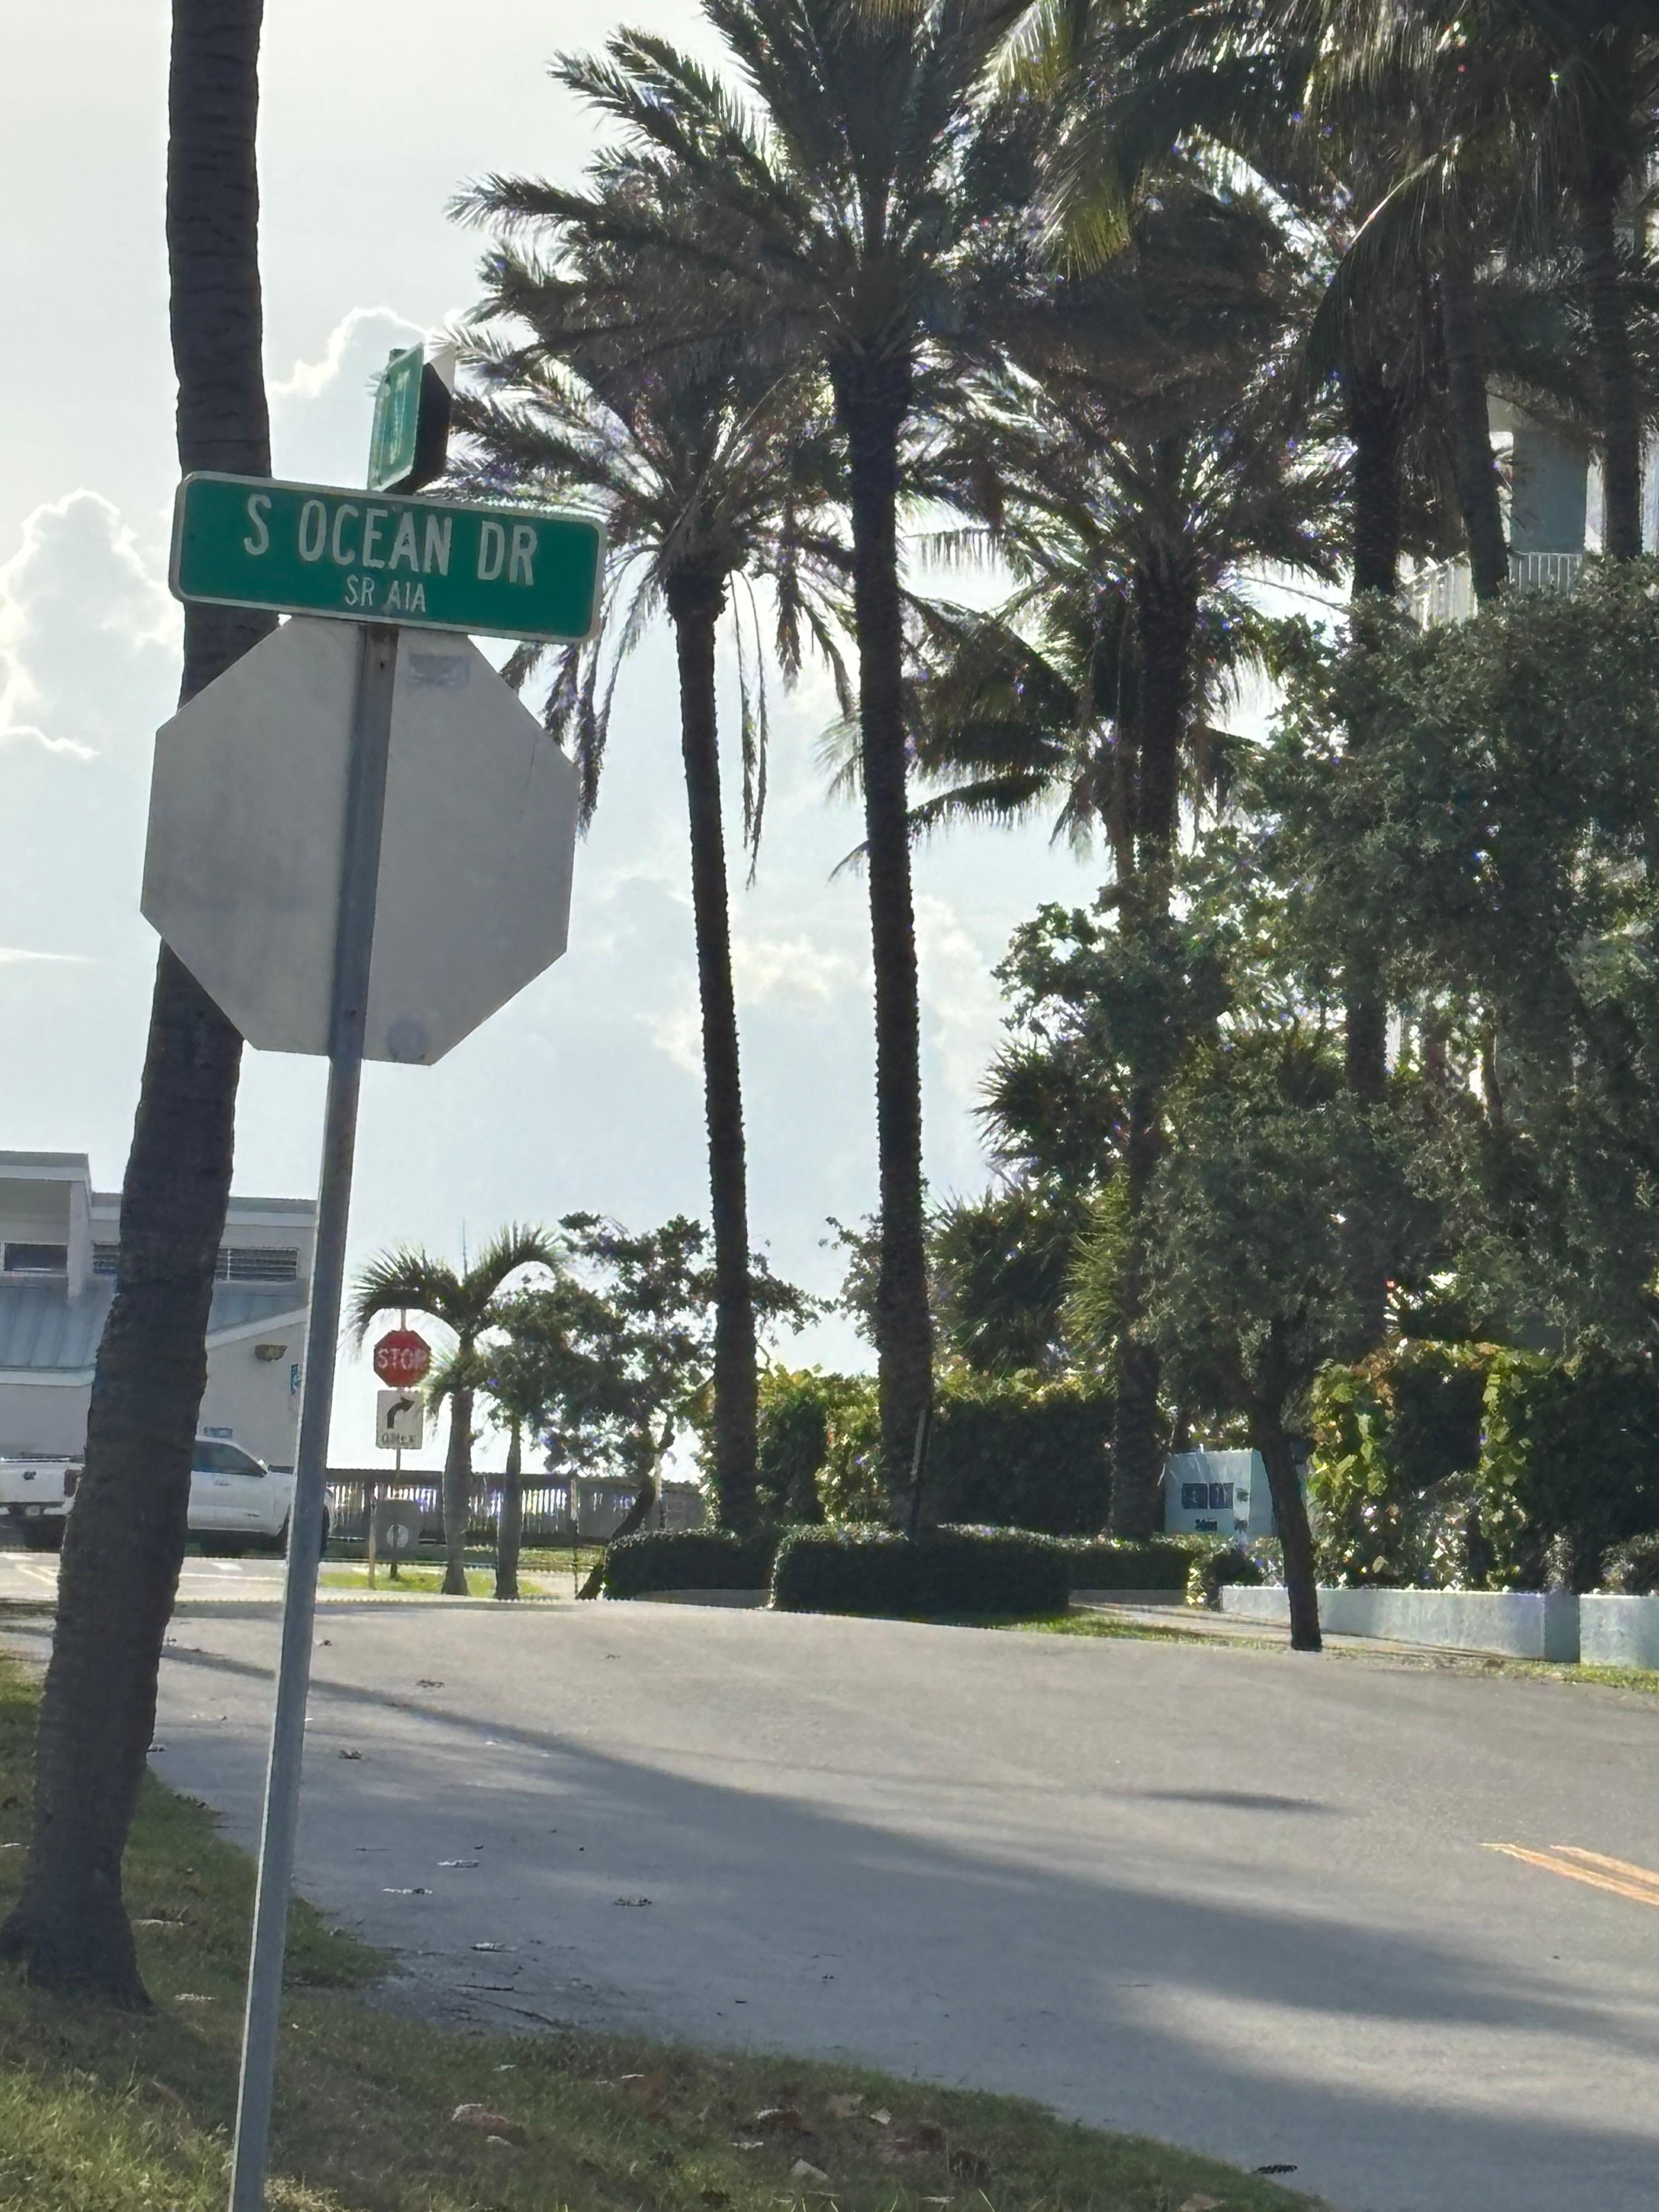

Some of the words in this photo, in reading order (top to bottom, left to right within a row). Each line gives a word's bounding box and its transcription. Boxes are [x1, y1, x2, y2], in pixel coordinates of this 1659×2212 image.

[244, 494, 272, 555] S
[298, 500, 452, 576] OCEAN
[477, 521, 538, 585] DR
[345, 575, 375, 606] SR
[377, 1348, 427, 1370] STOP
